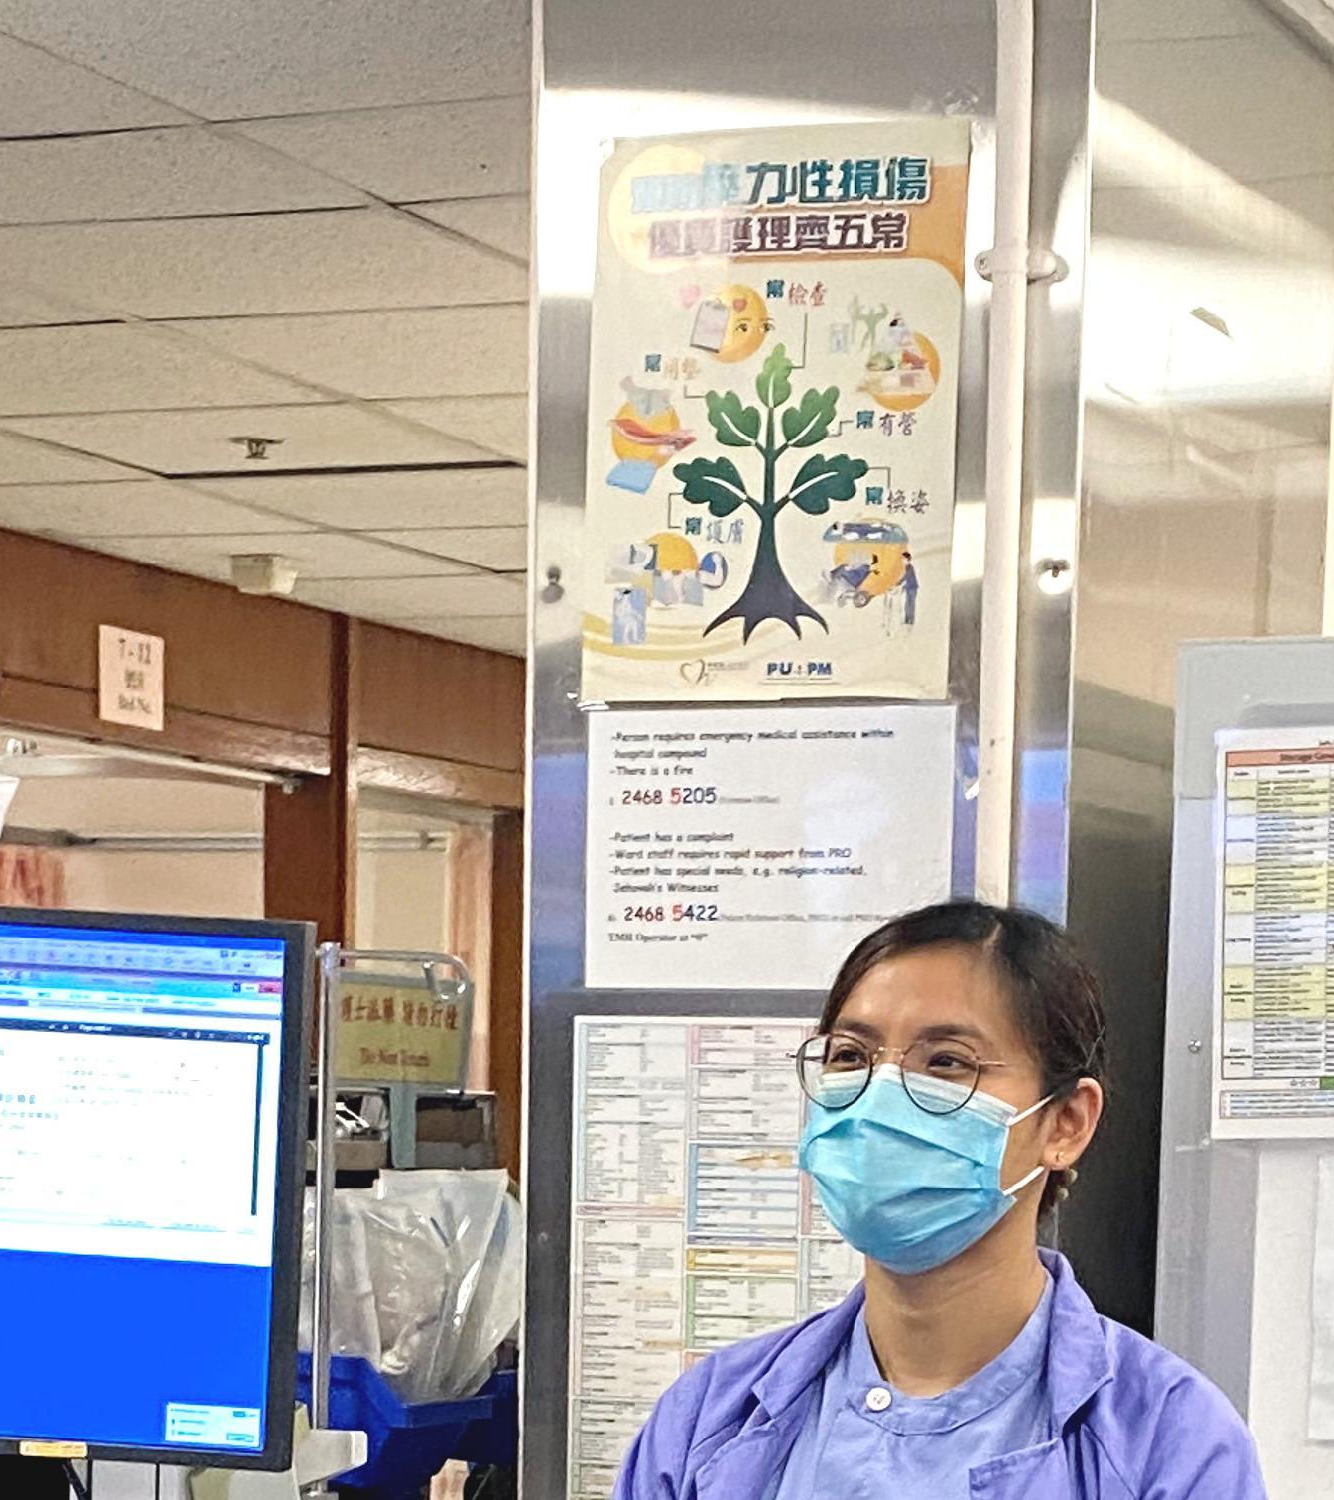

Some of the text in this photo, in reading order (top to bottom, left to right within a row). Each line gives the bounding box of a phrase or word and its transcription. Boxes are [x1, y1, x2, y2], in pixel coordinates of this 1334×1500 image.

[632, 158, 928, 208] 力性損傷
[622, 789, 663, 805] 2468
[670, 786, 717, 804] 5205
[755, 849, 794, 861] support
[798, 848, 824, 858] from
[624, 906, 664, 922] 2468
[672, 904, 718, 922] 5422
